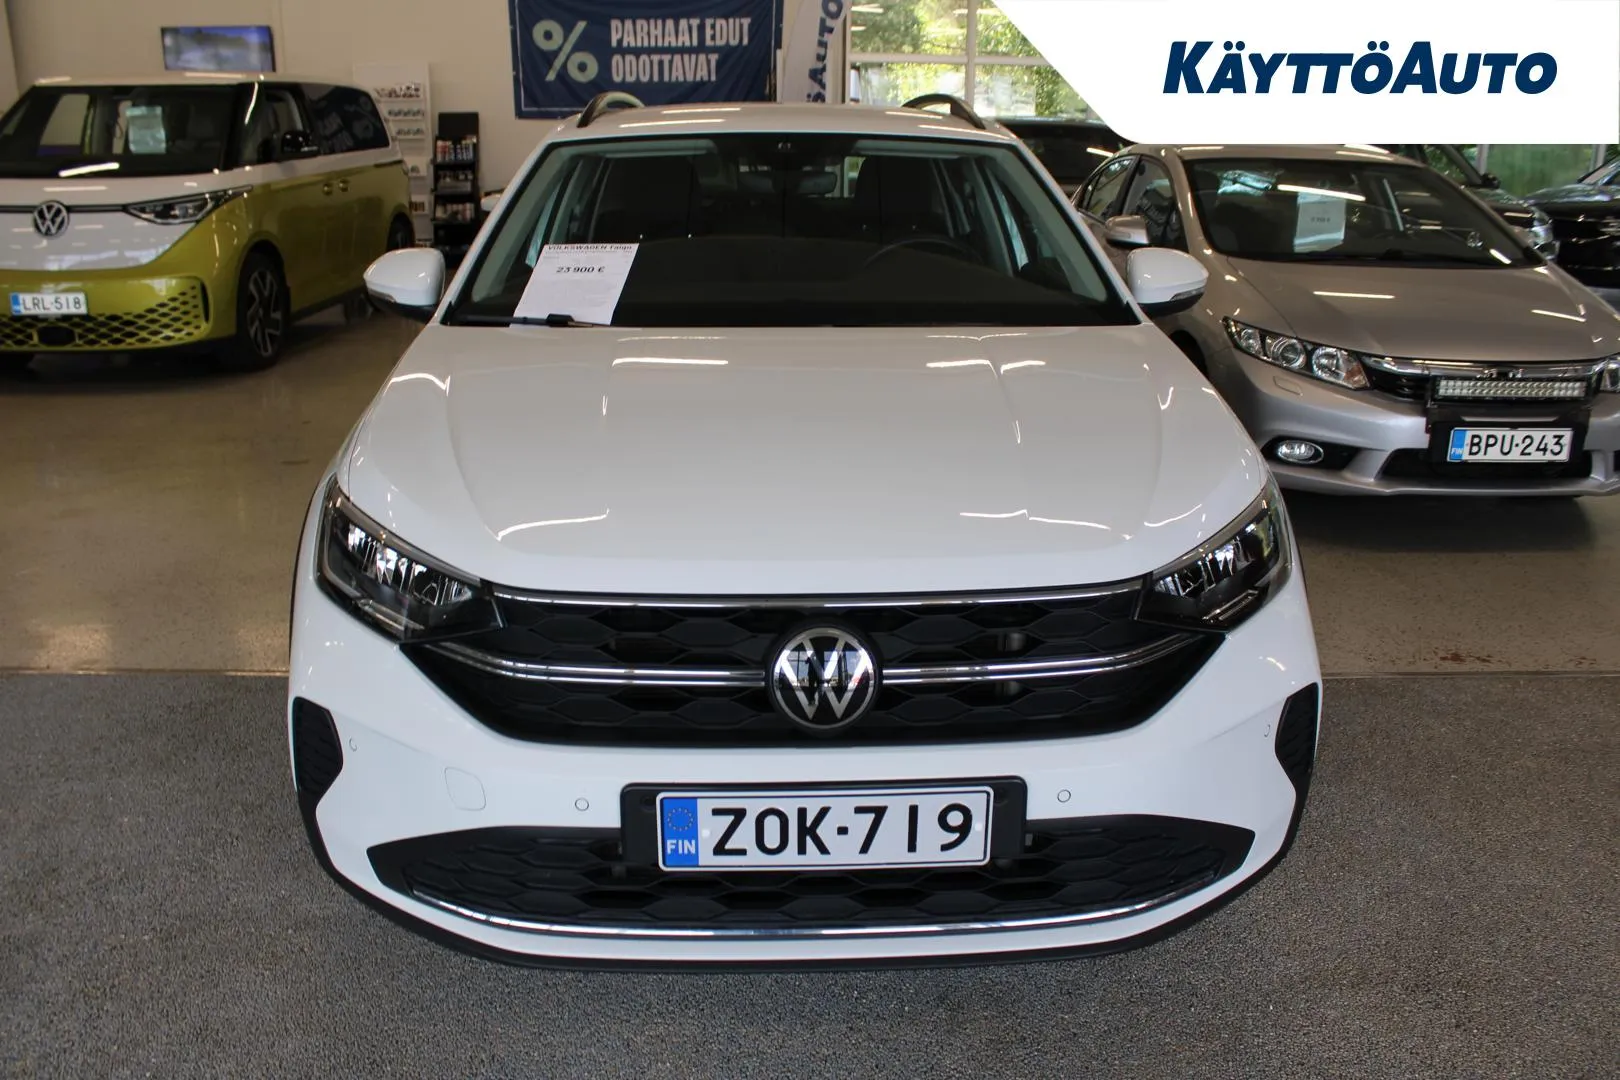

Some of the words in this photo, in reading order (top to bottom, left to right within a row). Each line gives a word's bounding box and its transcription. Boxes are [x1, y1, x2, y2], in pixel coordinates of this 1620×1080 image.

[610, 18, 699, 48] PARHAAT
[705, 18, 751, 46] EDUT
[532, 19, 599, 83] %
[611, 53, 719, 83] ODOTTAVAT
[22, 296, 82, 311] LRL-518
[1468, 434, 1565, 456] BPU-243
[666, 839, 696, 855] FIN
[711, 803, 975, 857] ZOK-719
